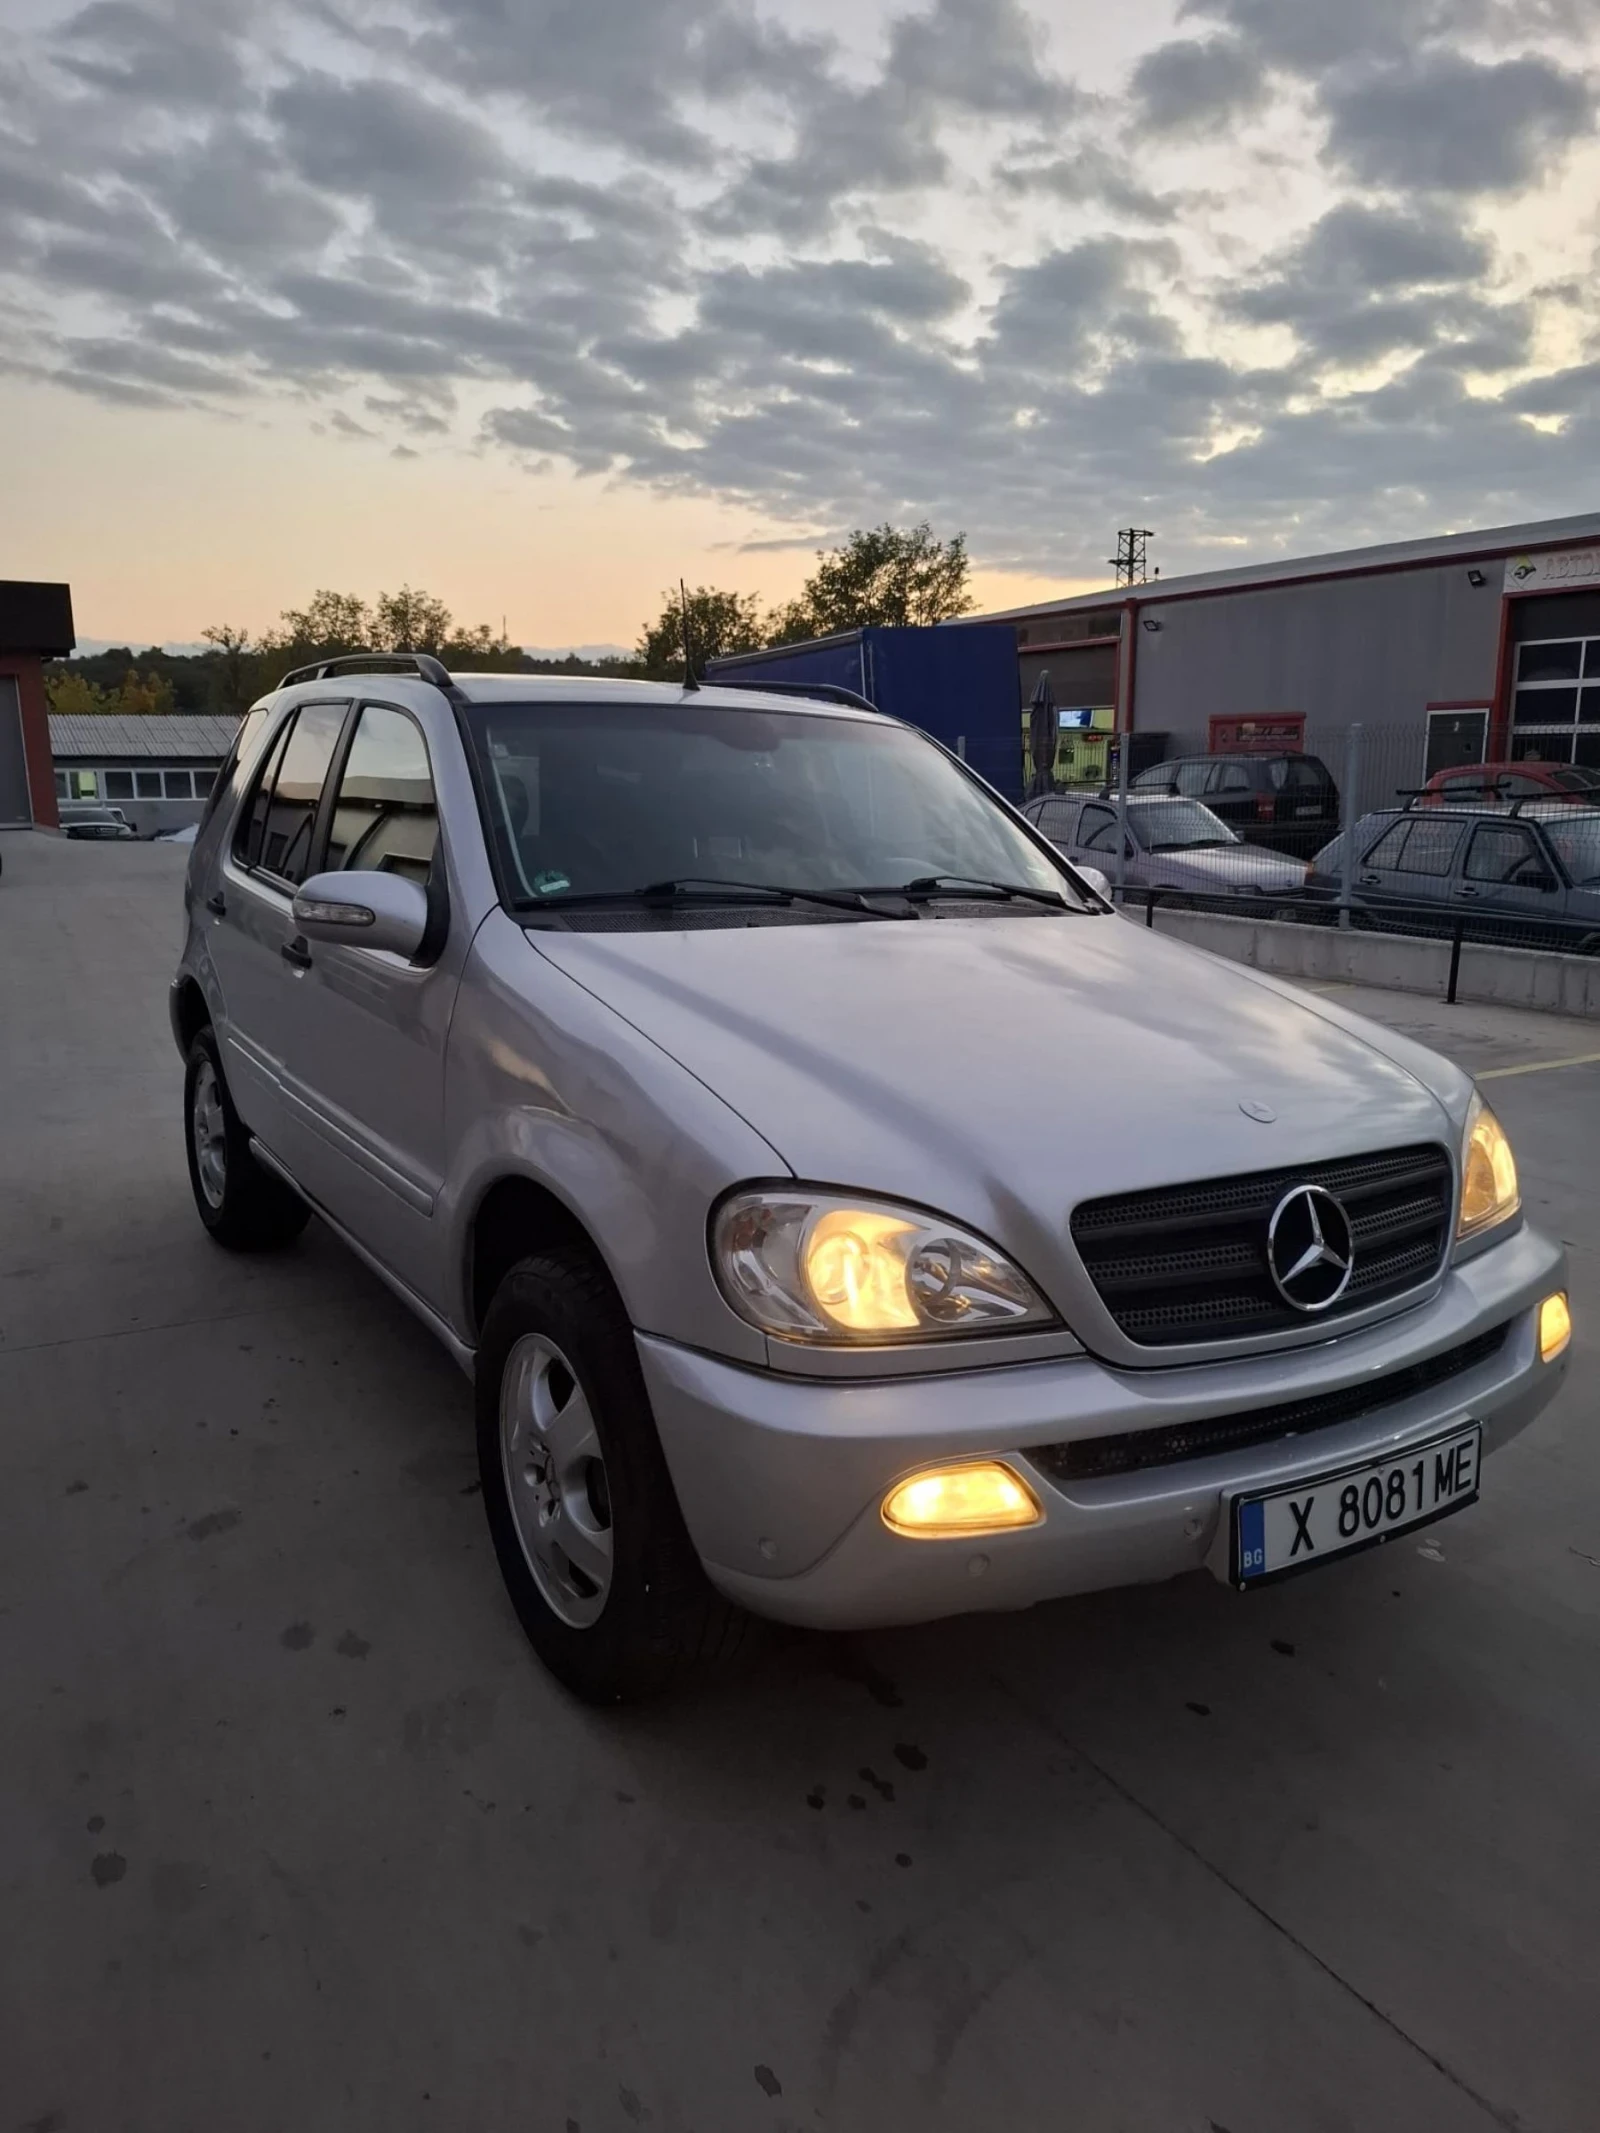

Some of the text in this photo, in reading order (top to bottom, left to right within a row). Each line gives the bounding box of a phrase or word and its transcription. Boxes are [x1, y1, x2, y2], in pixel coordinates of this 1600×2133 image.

[1543, 551, 1600, 580] АВТО
[1290, 1497, 1315, 1556] X
[1243, 1548, 1263, 1568] BG
